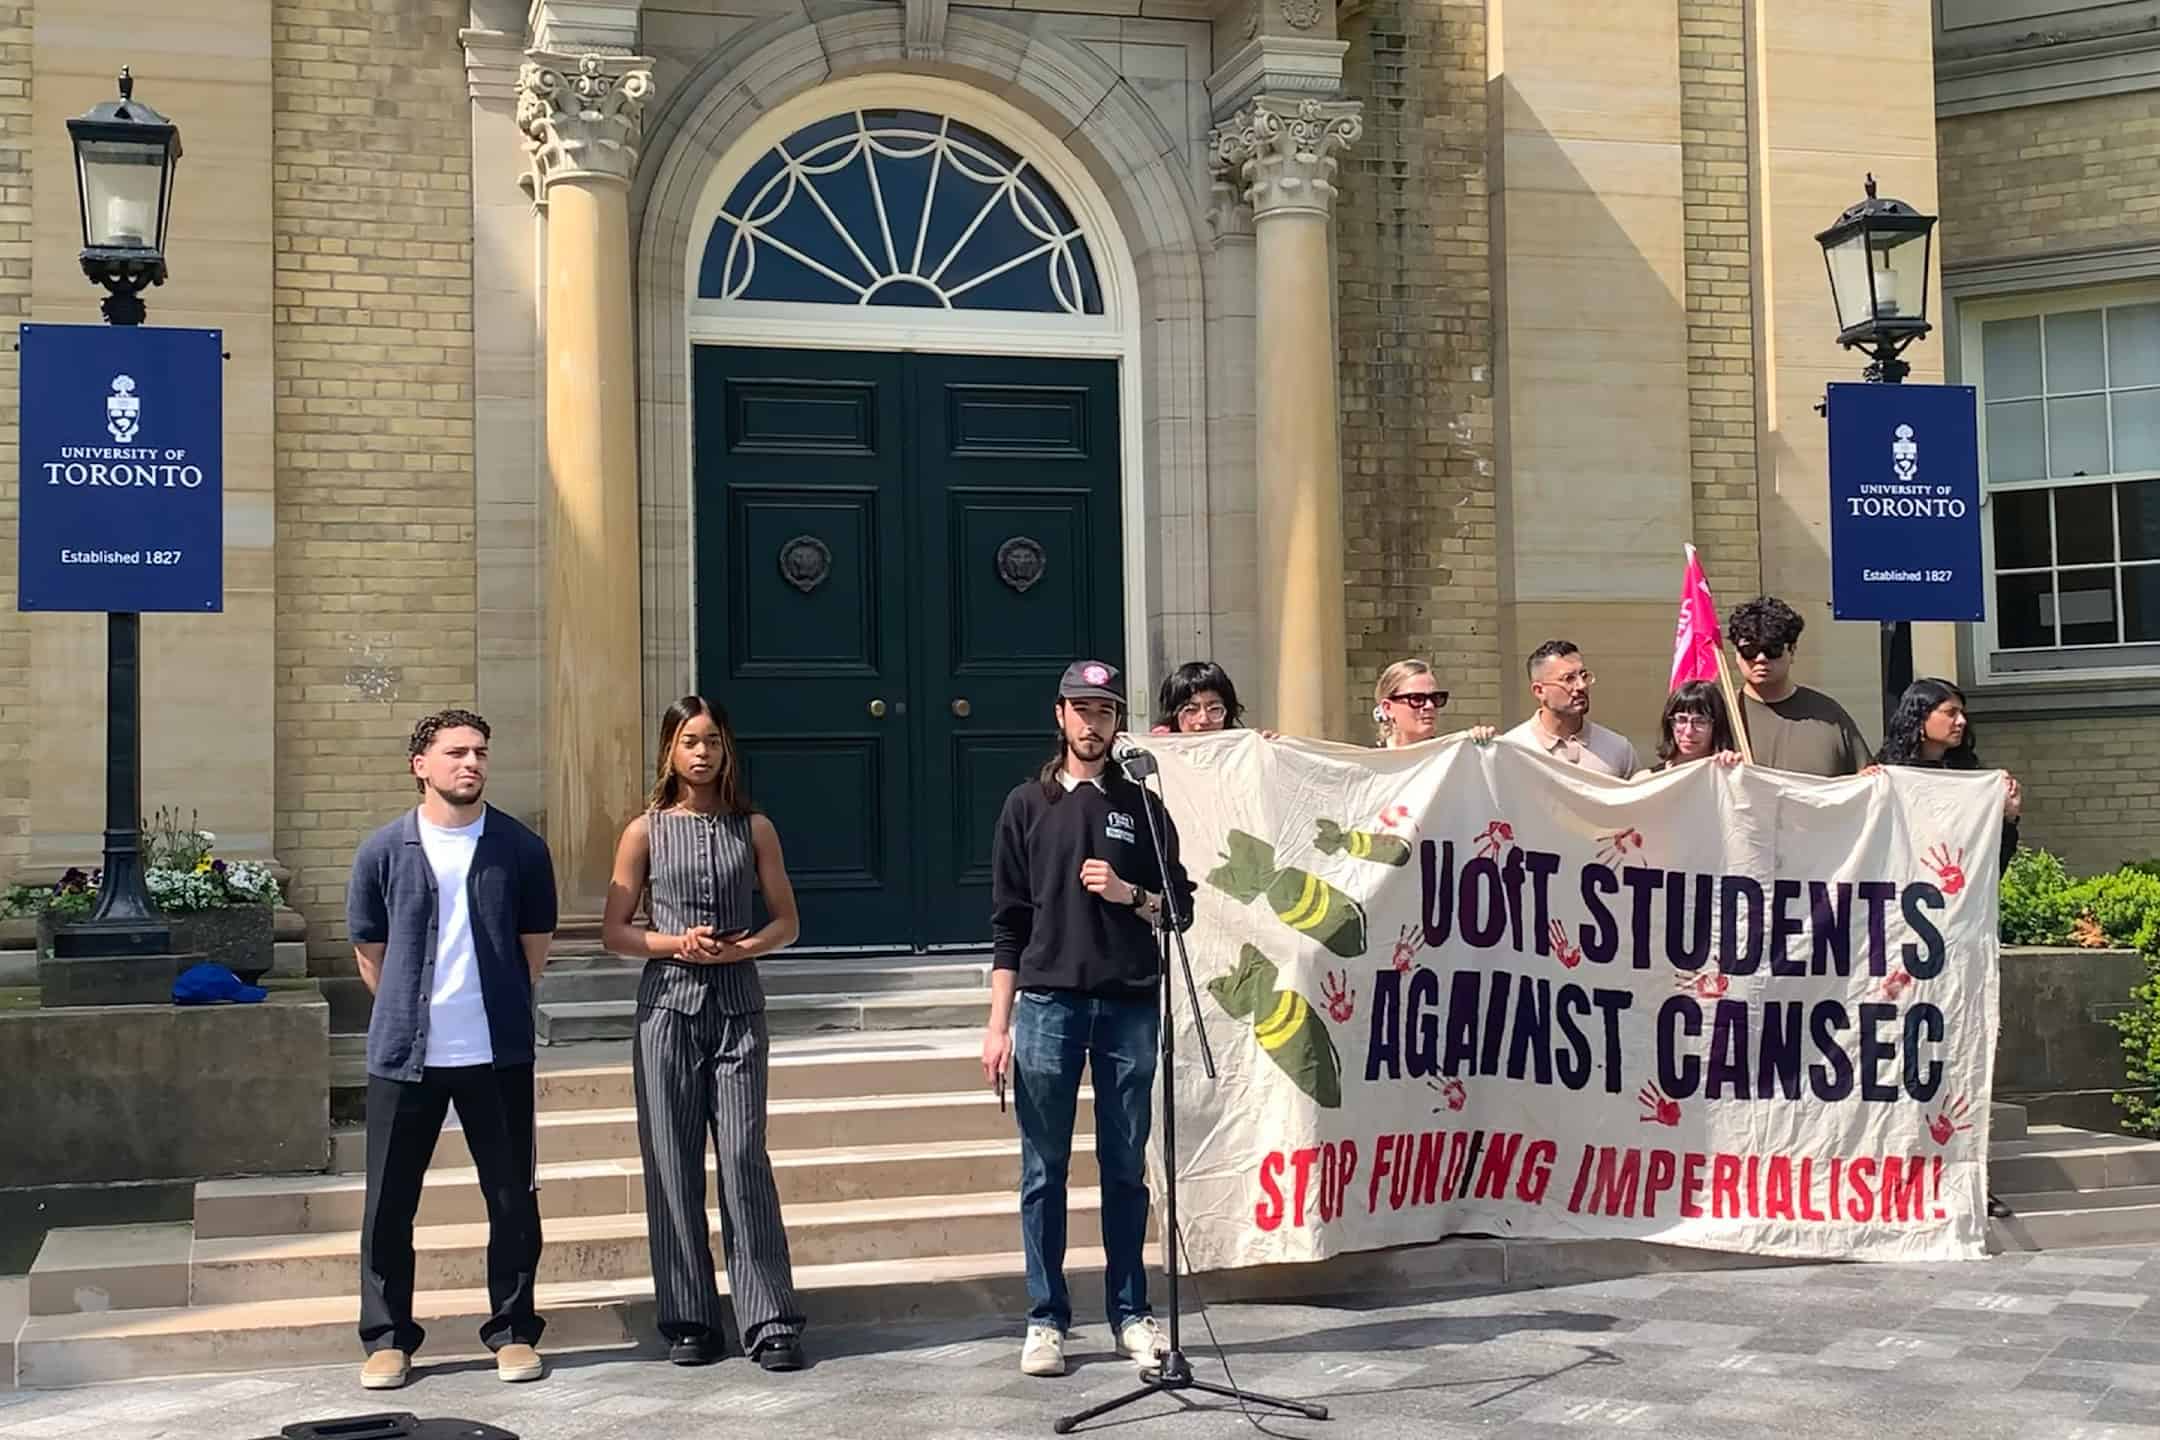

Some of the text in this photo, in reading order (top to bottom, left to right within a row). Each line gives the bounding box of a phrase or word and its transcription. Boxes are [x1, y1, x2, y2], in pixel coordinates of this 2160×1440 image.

[61, 447, 186, 461] UNIVERSITY OF
[43, 462, 203, 488] TORONTO
[1860, 484, 1952, 496] UNIVERSITY OF
[1847, 497, 1966, 518] TORONTO
[61, 549, 182, 565] Established 1827
[1863, 569, 1953, 582] Established 1827
[1578, 862, 1947, 981] STUDENTS
[1364, 966, 1945, 1103] AGAINST CANSEC
[1255, 1130, 1945, 1232] STOP FUNDING IMPERIALISM!
